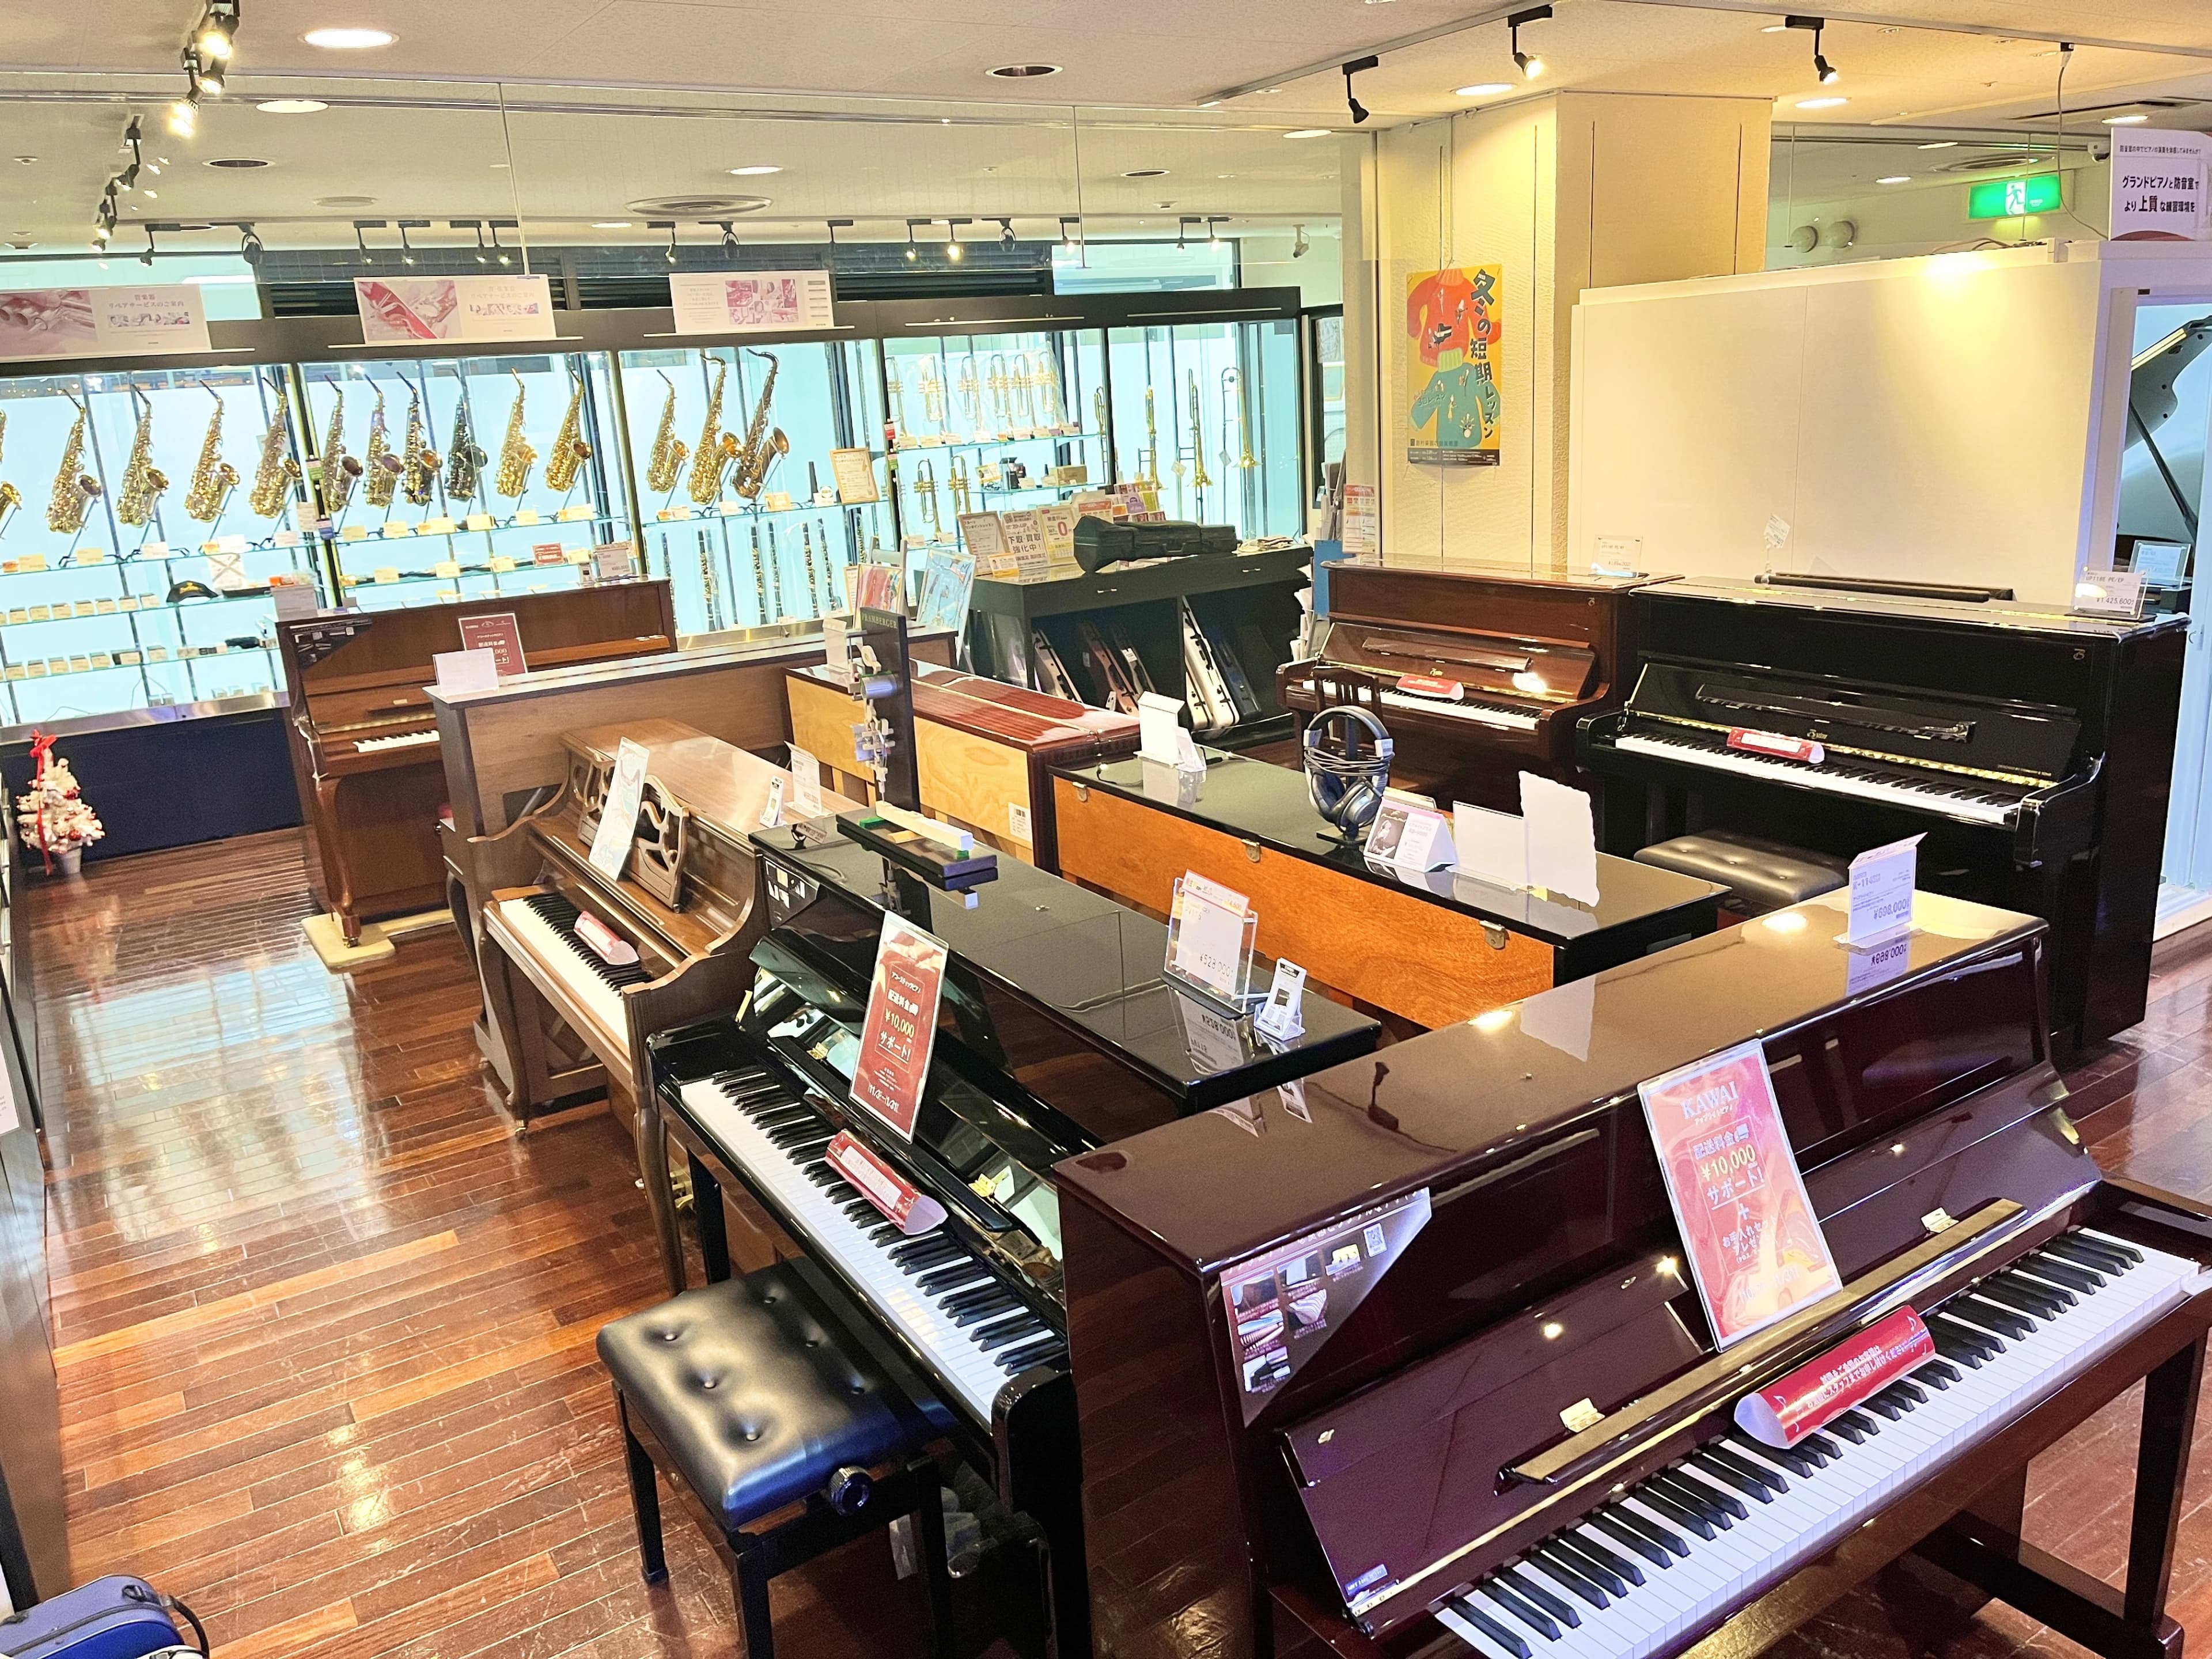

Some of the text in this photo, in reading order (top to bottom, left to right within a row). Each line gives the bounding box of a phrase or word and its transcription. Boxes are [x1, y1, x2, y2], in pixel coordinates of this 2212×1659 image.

[1471, 268, 1500, 439] 冬の短期レッスン
[1008, 533, 1041, 544] 下取・買取
[861, 612, 897, 629] PRAMBERGER
[885, 1008, 915, 1038] ¥10,000
[880, 1031, 911, 1061] サポート!
[1681, 1081, 1738, 1120] KAWAI
[1693, 1131, 1736, 1160] 配送料金
[1700, 1143, 1756, 1182] ¥10,000
[1707, 1166, 1764, 1205] サポート!
